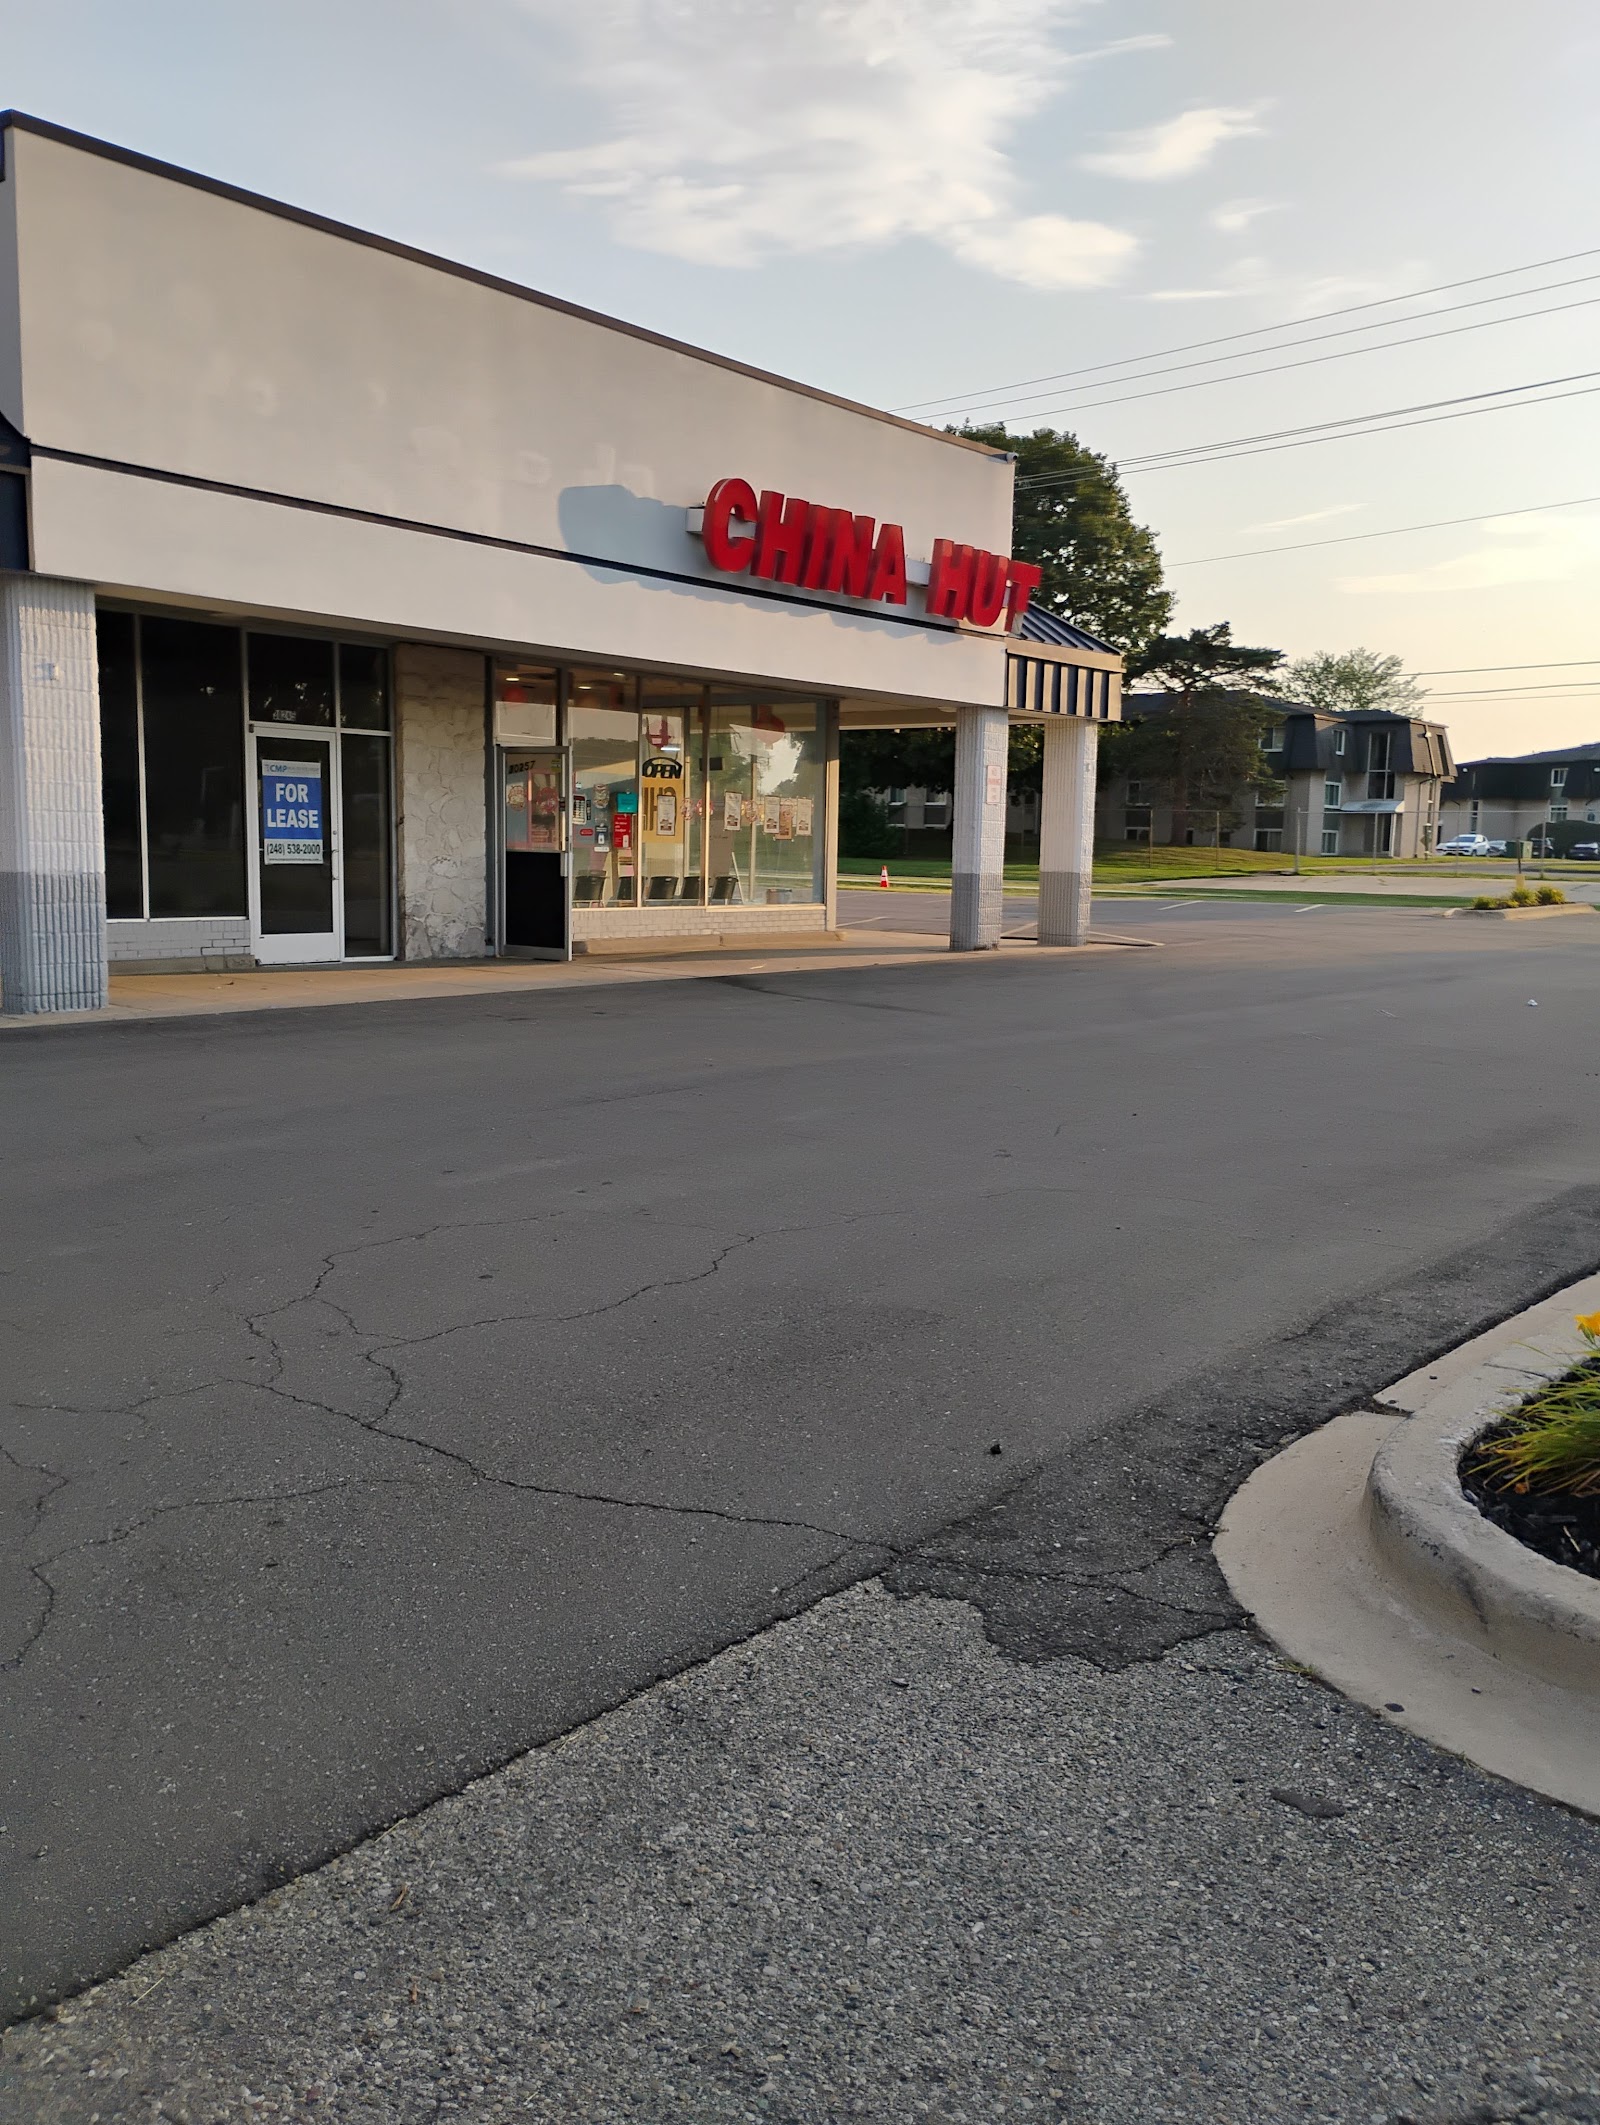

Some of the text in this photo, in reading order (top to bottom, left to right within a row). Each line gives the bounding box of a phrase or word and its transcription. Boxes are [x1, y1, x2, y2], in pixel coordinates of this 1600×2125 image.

[703, 478, 1043, 632] CHINA HUT
[270, 764, 288, 773] CMP
[642, 760, 682, 778] OPEN
[275, 783, 309, 803] FOR
[267, 808, 319, 829] LEASE
[266, 843, 321, 856] (248) 538-2000
